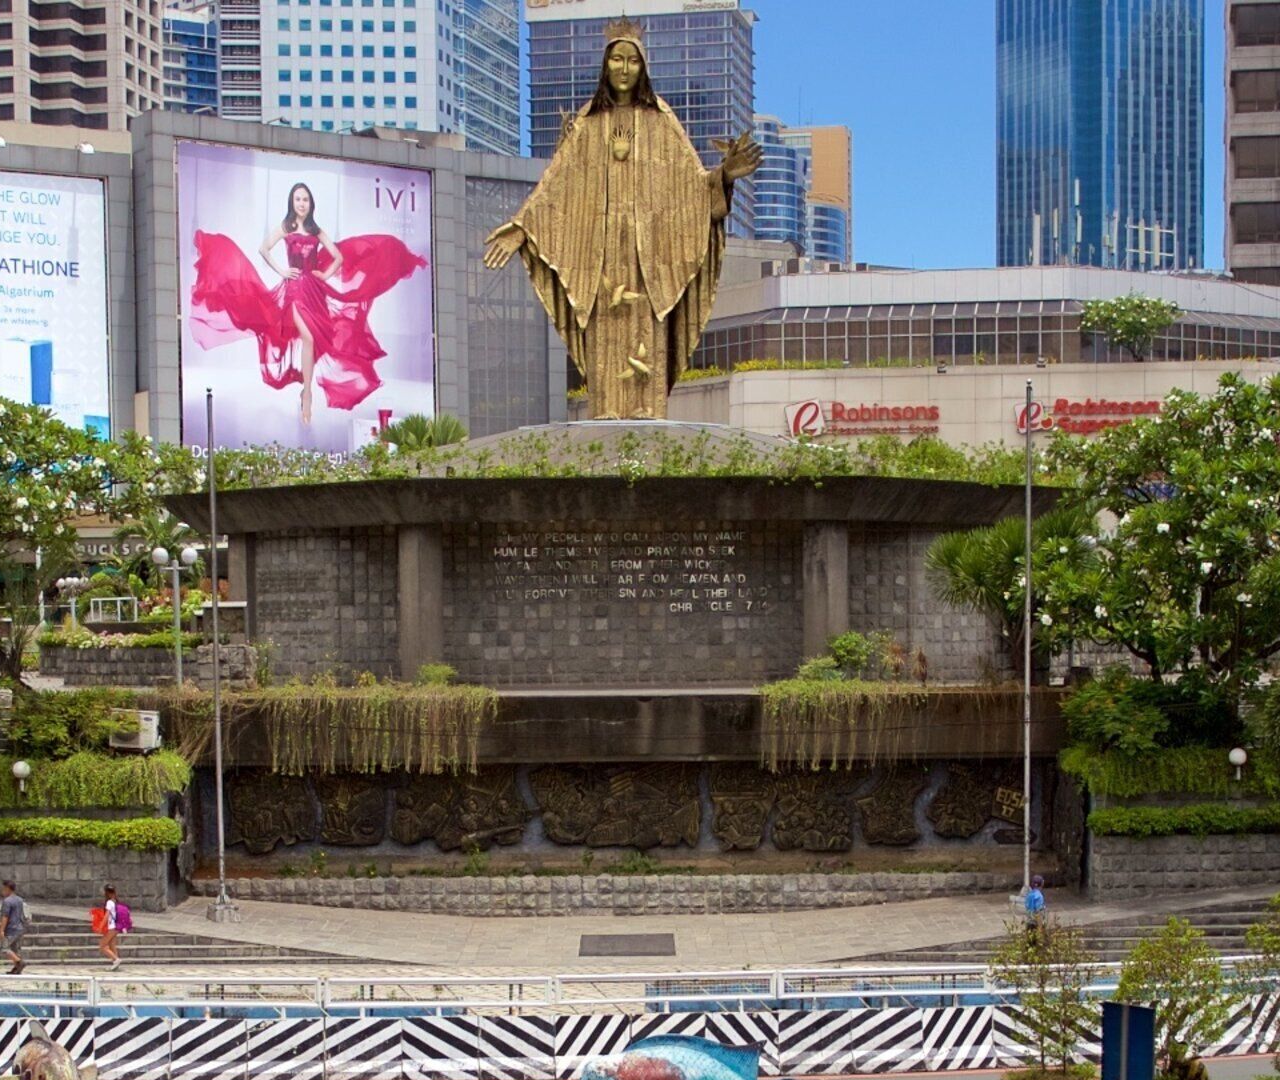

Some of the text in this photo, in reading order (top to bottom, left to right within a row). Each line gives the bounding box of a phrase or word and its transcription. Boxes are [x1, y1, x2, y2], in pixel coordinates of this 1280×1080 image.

[20, 191, 61, 206] GLOW
[375, 177, 415, 212] ivi
[13, 211, 46, 225] WILL
[27, 232, 61, 246] YOU.
[831, 401, 939, 422] Robinsons
[1053, 398, 1161, 415] Robinson
[494, 547, 538, 558] HUMLE
[639, 574, 669, 583] FOM
[619, 588, 636, 599] SIN
